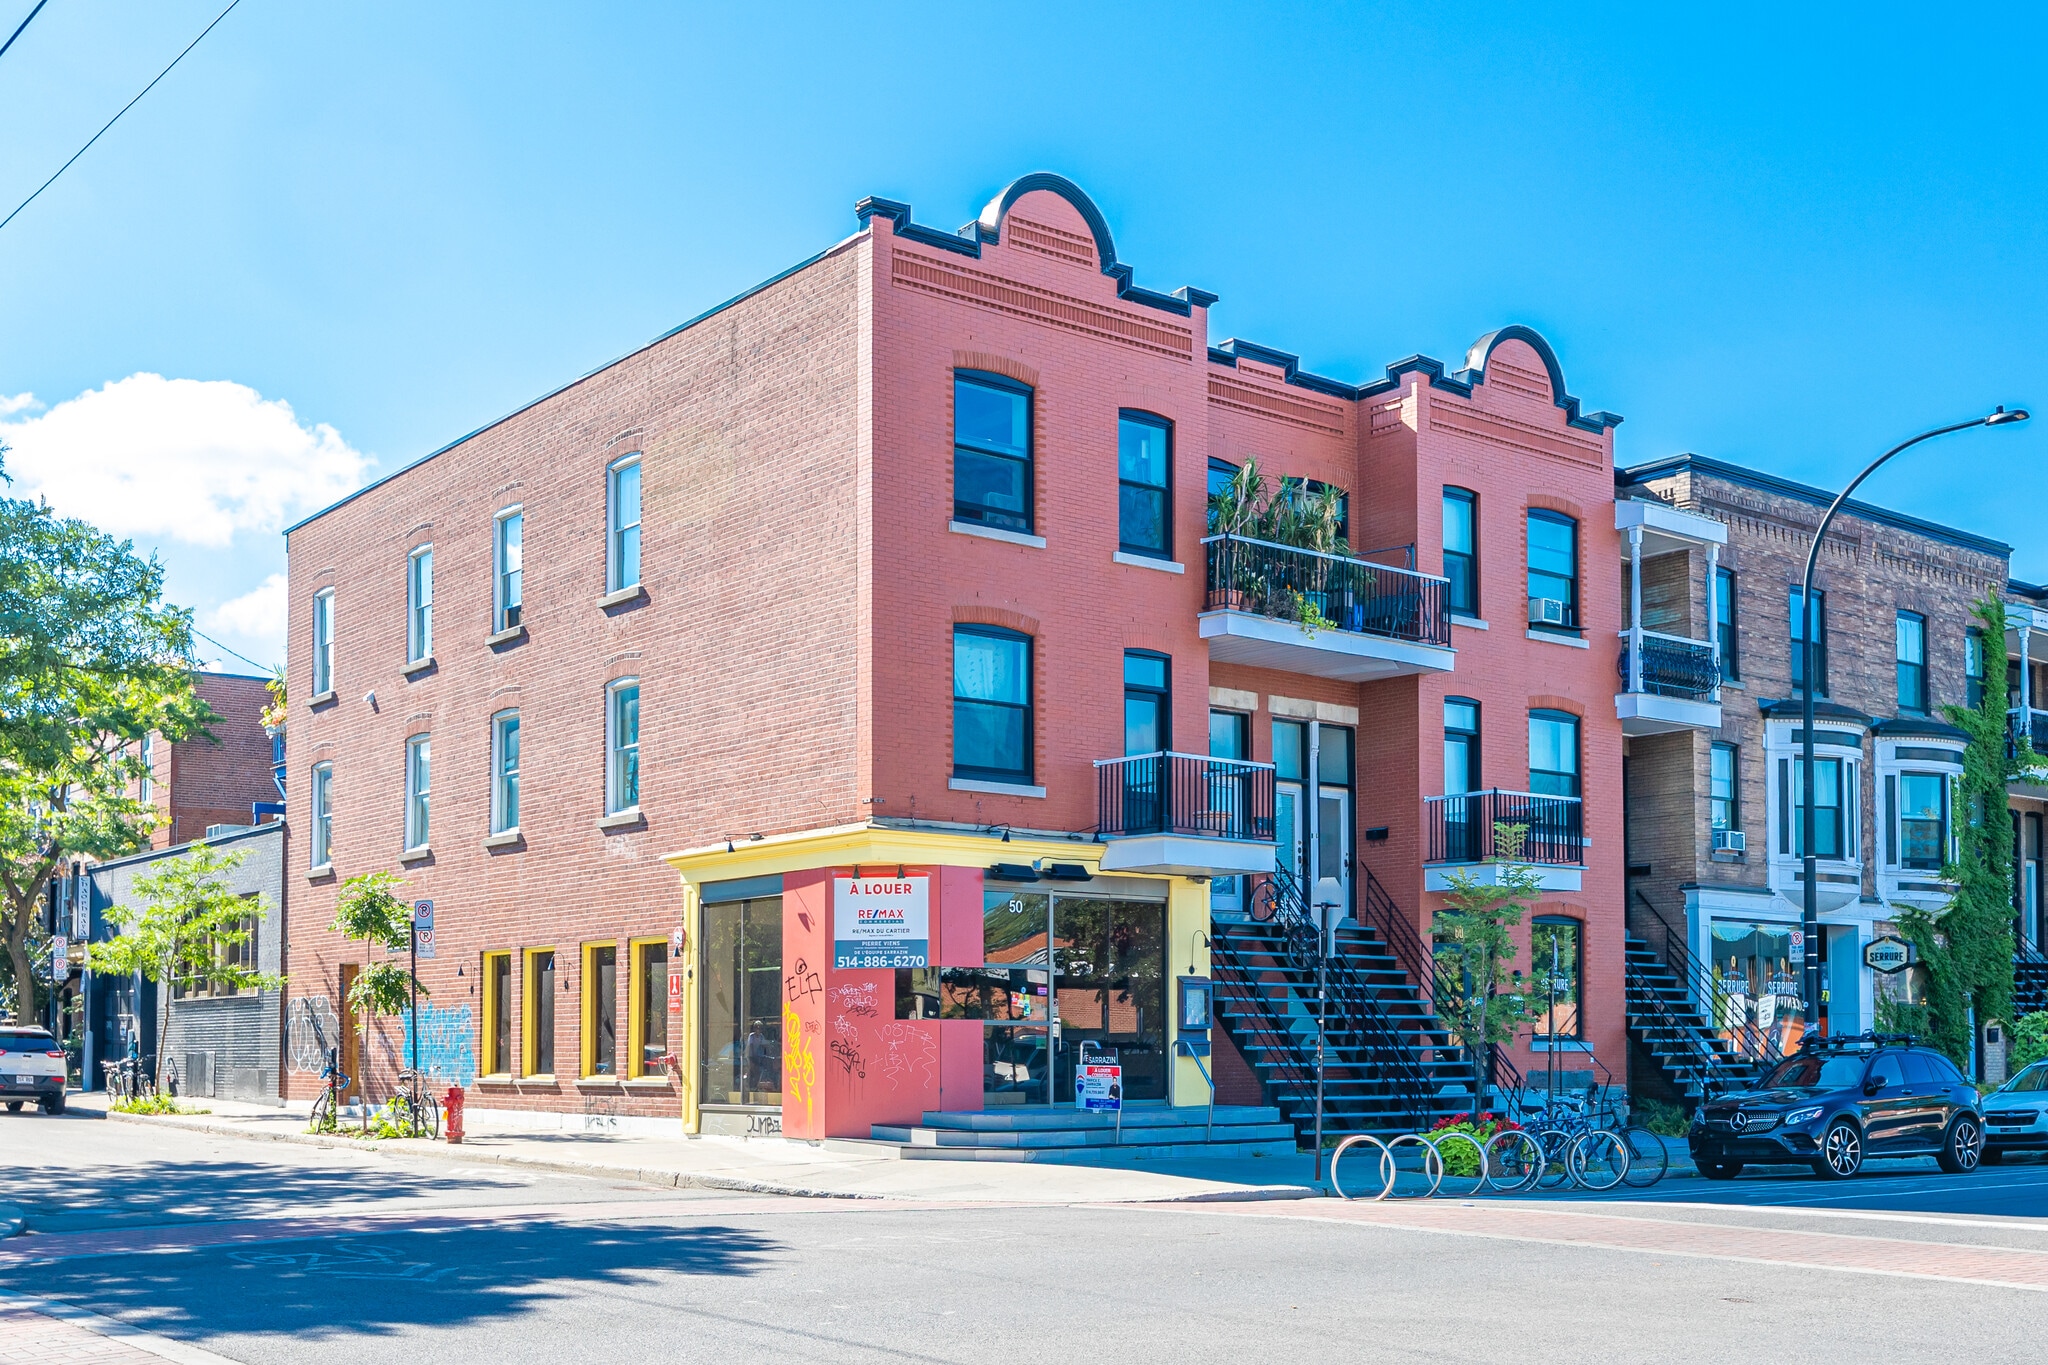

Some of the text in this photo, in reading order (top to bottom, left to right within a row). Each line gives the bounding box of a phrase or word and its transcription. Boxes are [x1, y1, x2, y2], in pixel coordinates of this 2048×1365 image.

[849, 881, 912, 895] À LOUER
[858, 909, 904, 918] RE/MAX
[1009, 900, 1023, 914] 50
[837, 955, 925, 968] 514-886-6270
[1869, 951, 1904, 962] SERRURE
[1767, 981, 1799, 997] SERRURE
